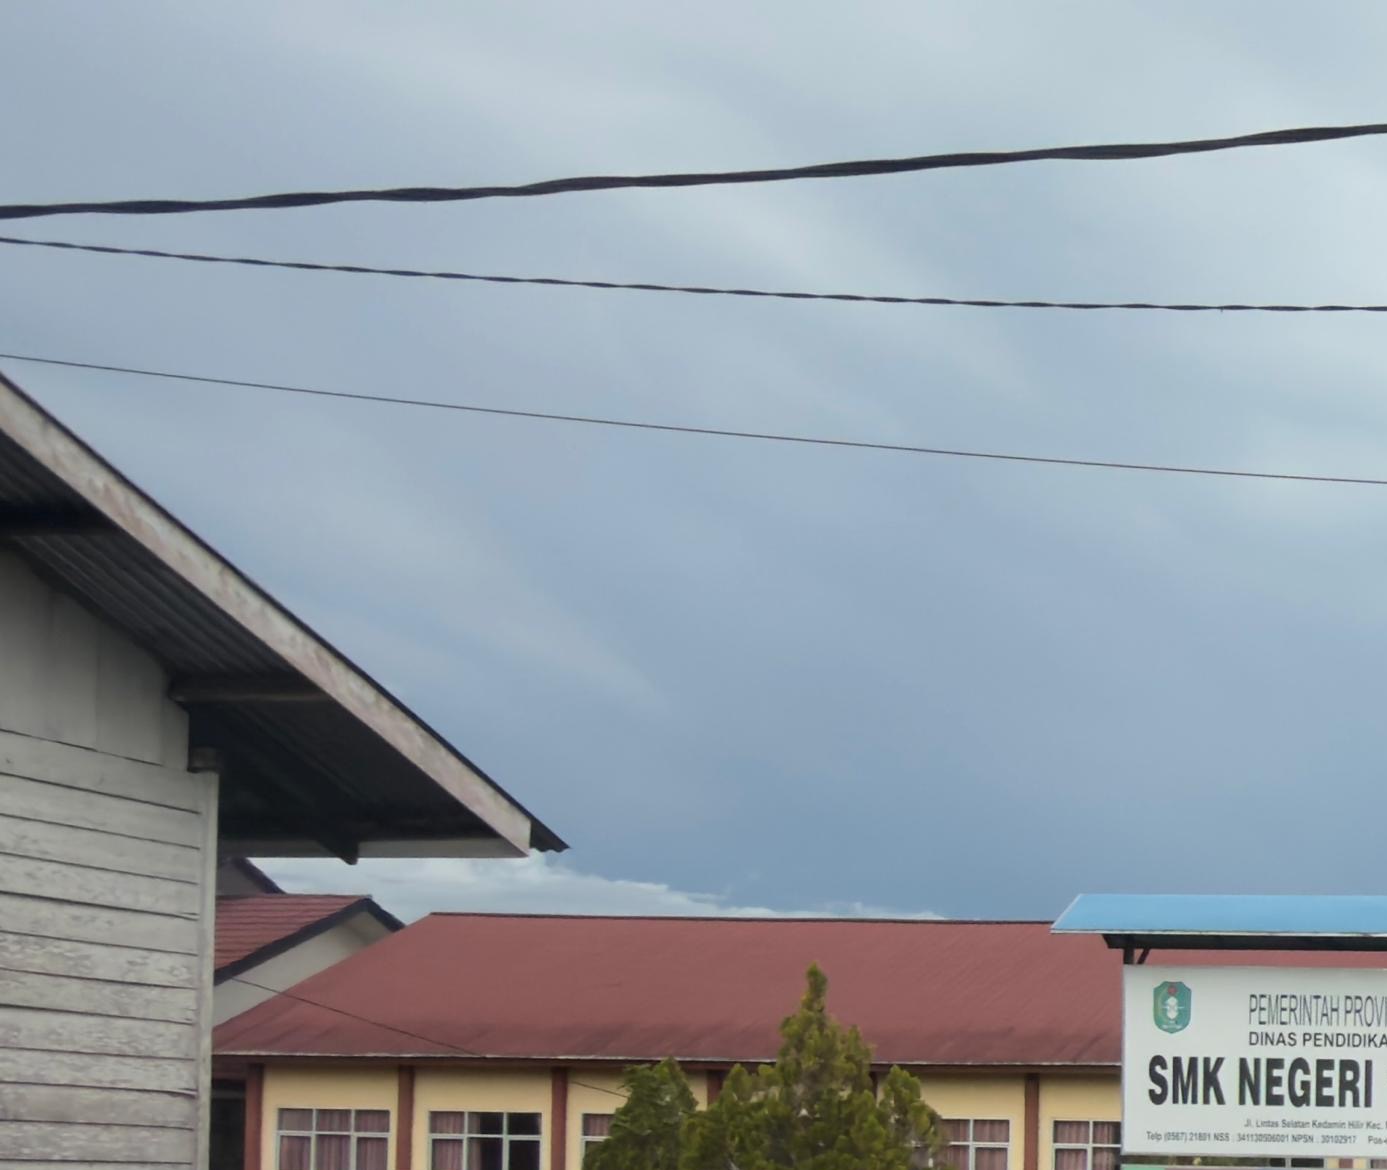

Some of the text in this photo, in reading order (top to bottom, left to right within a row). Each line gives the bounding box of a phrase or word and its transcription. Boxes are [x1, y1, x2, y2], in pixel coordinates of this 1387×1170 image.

[1248, 994, 1340, 1028] PEMERINTAH
[1248, 1031, 1297, 1047] DINAS
[1148, 1055, 1227, 1106] SMK
[1238, 1057, 1373, 1109] NEGERI
[1146, 1131, 1162, 1142] Telp
[1213, 1132, 1230, 1142] NSS
